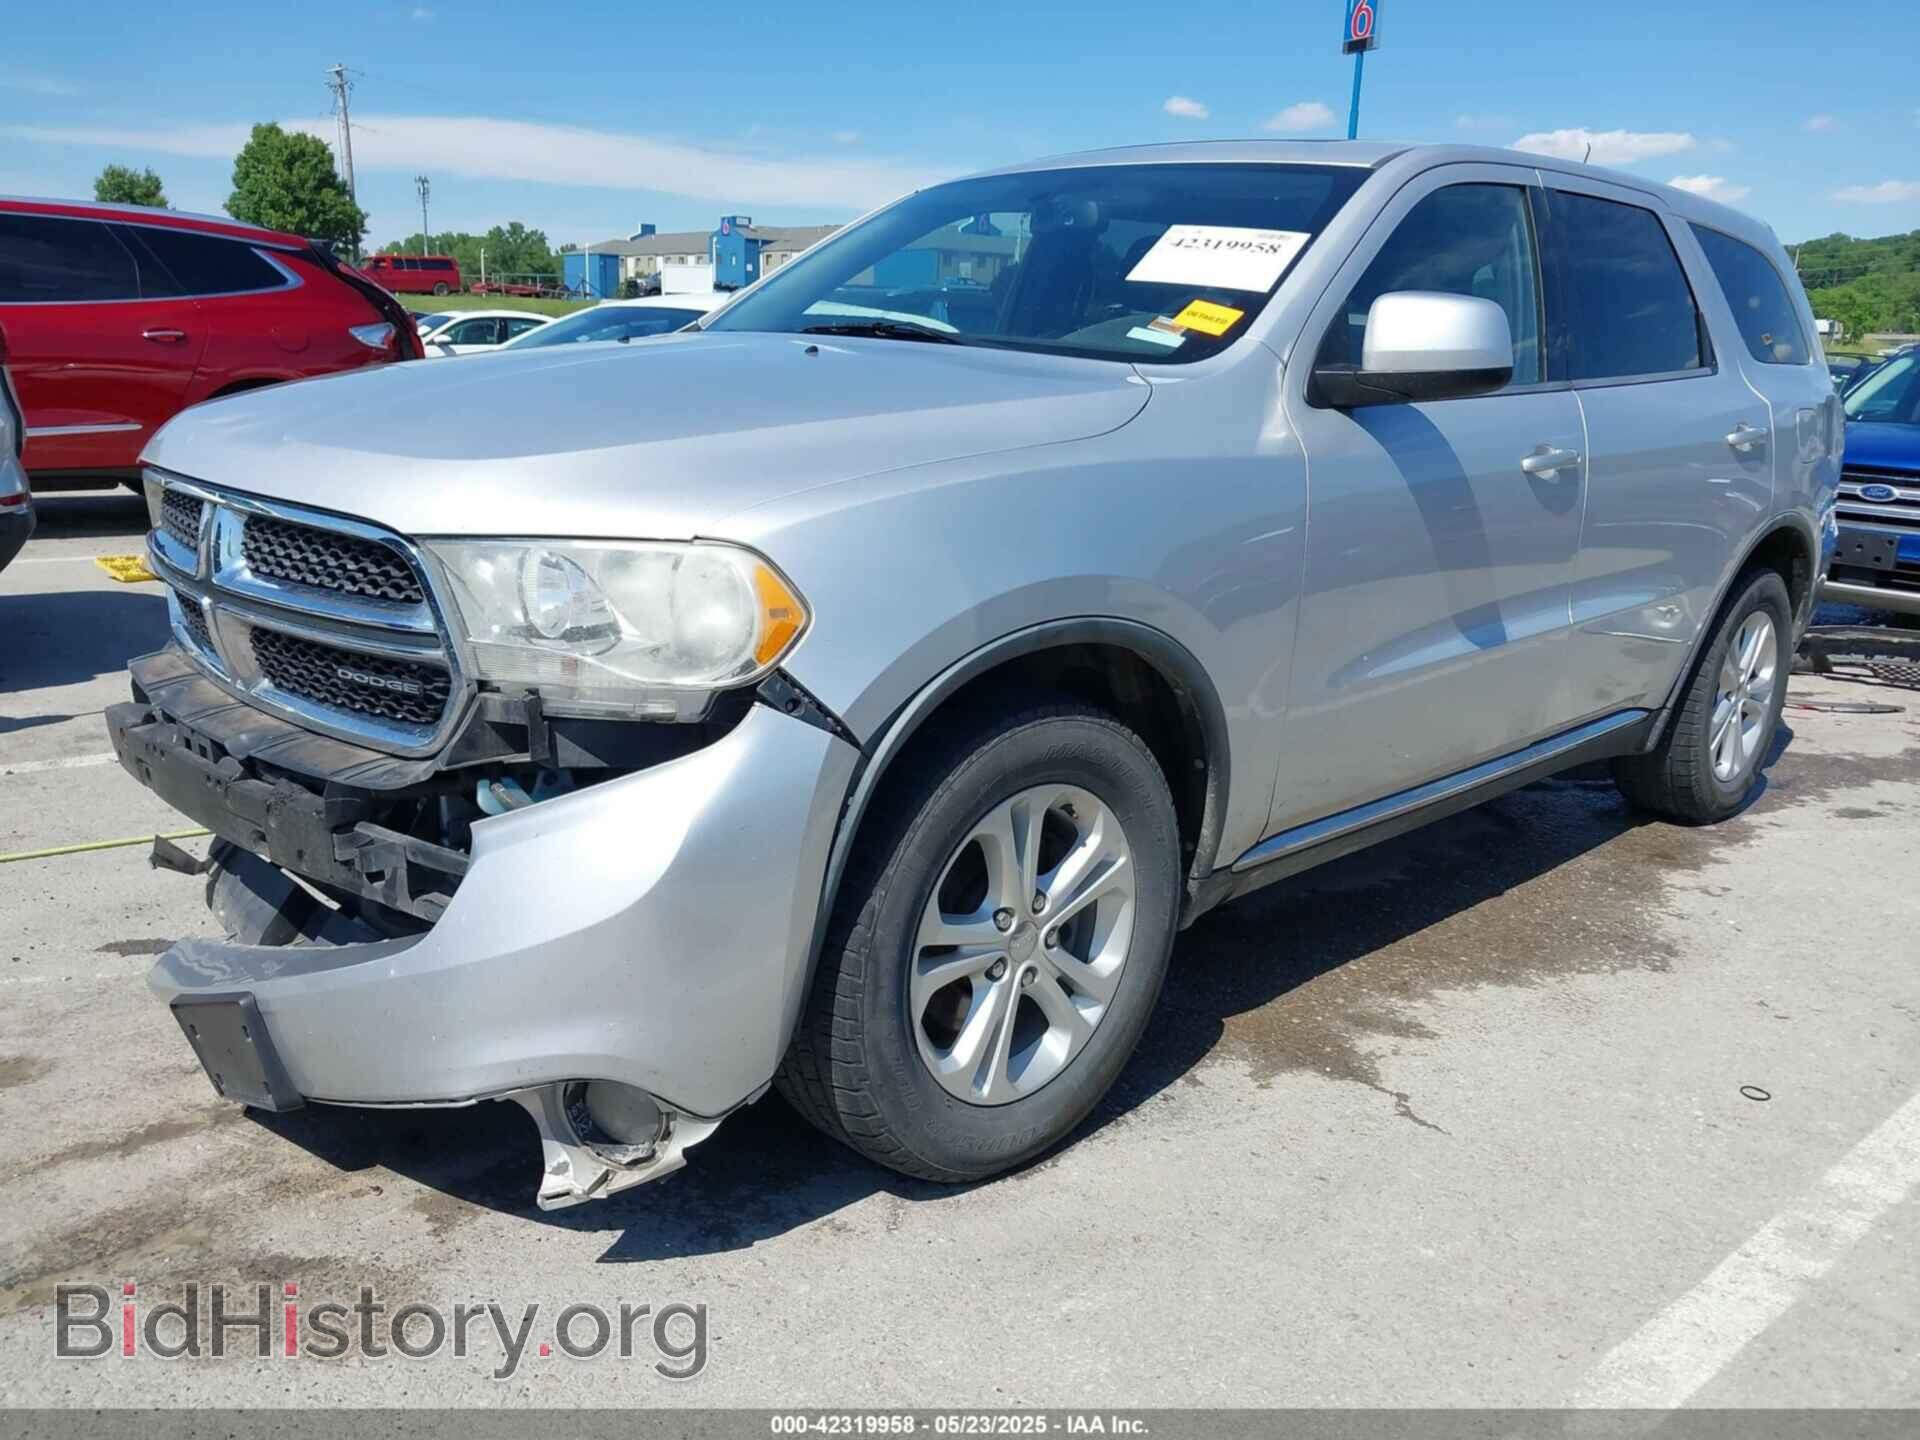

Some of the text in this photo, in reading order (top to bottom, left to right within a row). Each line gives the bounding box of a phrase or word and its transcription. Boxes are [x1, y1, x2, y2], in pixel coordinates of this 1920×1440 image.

[1351, 0, 1374, 40] 6
[1169, 237, 1283, 255] 42319958
[337, 668, 420, 695] DODGE
